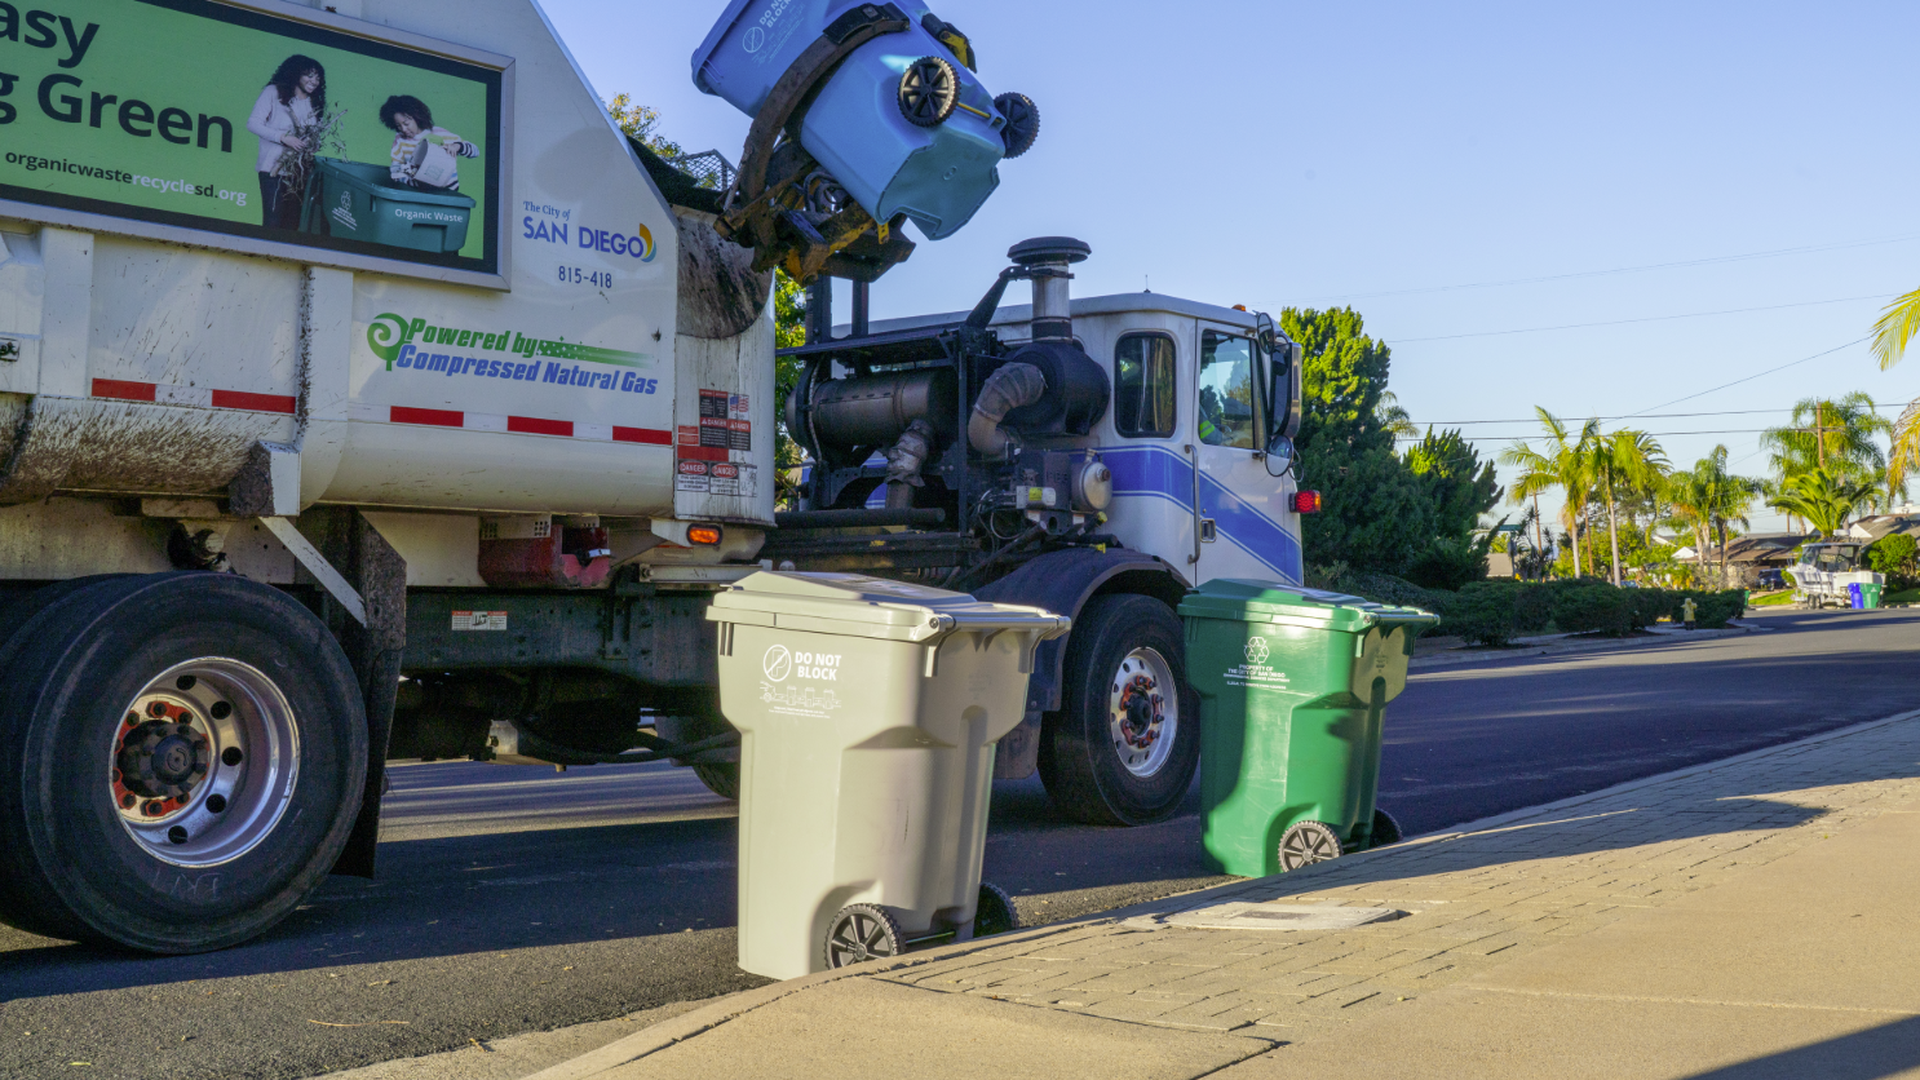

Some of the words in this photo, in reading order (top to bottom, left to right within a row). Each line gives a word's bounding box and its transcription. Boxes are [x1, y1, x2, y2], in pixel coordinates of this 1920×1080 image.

[759, 10, 772, 25] DO
[37, 73, 233, 153] Green
[5, 151, 247, 206] organicwasterecyclesd.org
[394, 208, 432, 220] Organic
[433, 211, 463, 222] Waste
[523, 201, 541, 213] The
[542, 204, 560, 219] City
[562, 209, 571, 221] of
[523, 216, 568, 245] SAN
[579, 226, 644, 259] DIEGO
[558, 265, 612, 289] 815-418
[406, 317, 511, 351] Powered
[396, 344, 542, 381] Compressed
[542, 362, 620, 391] Natural
[621, 371, 658, 395] Gas
[795, 651, 812, 665] DO
[815, 653, 842, 667] NOT
[797, 665, 837, 681] BLOCK
